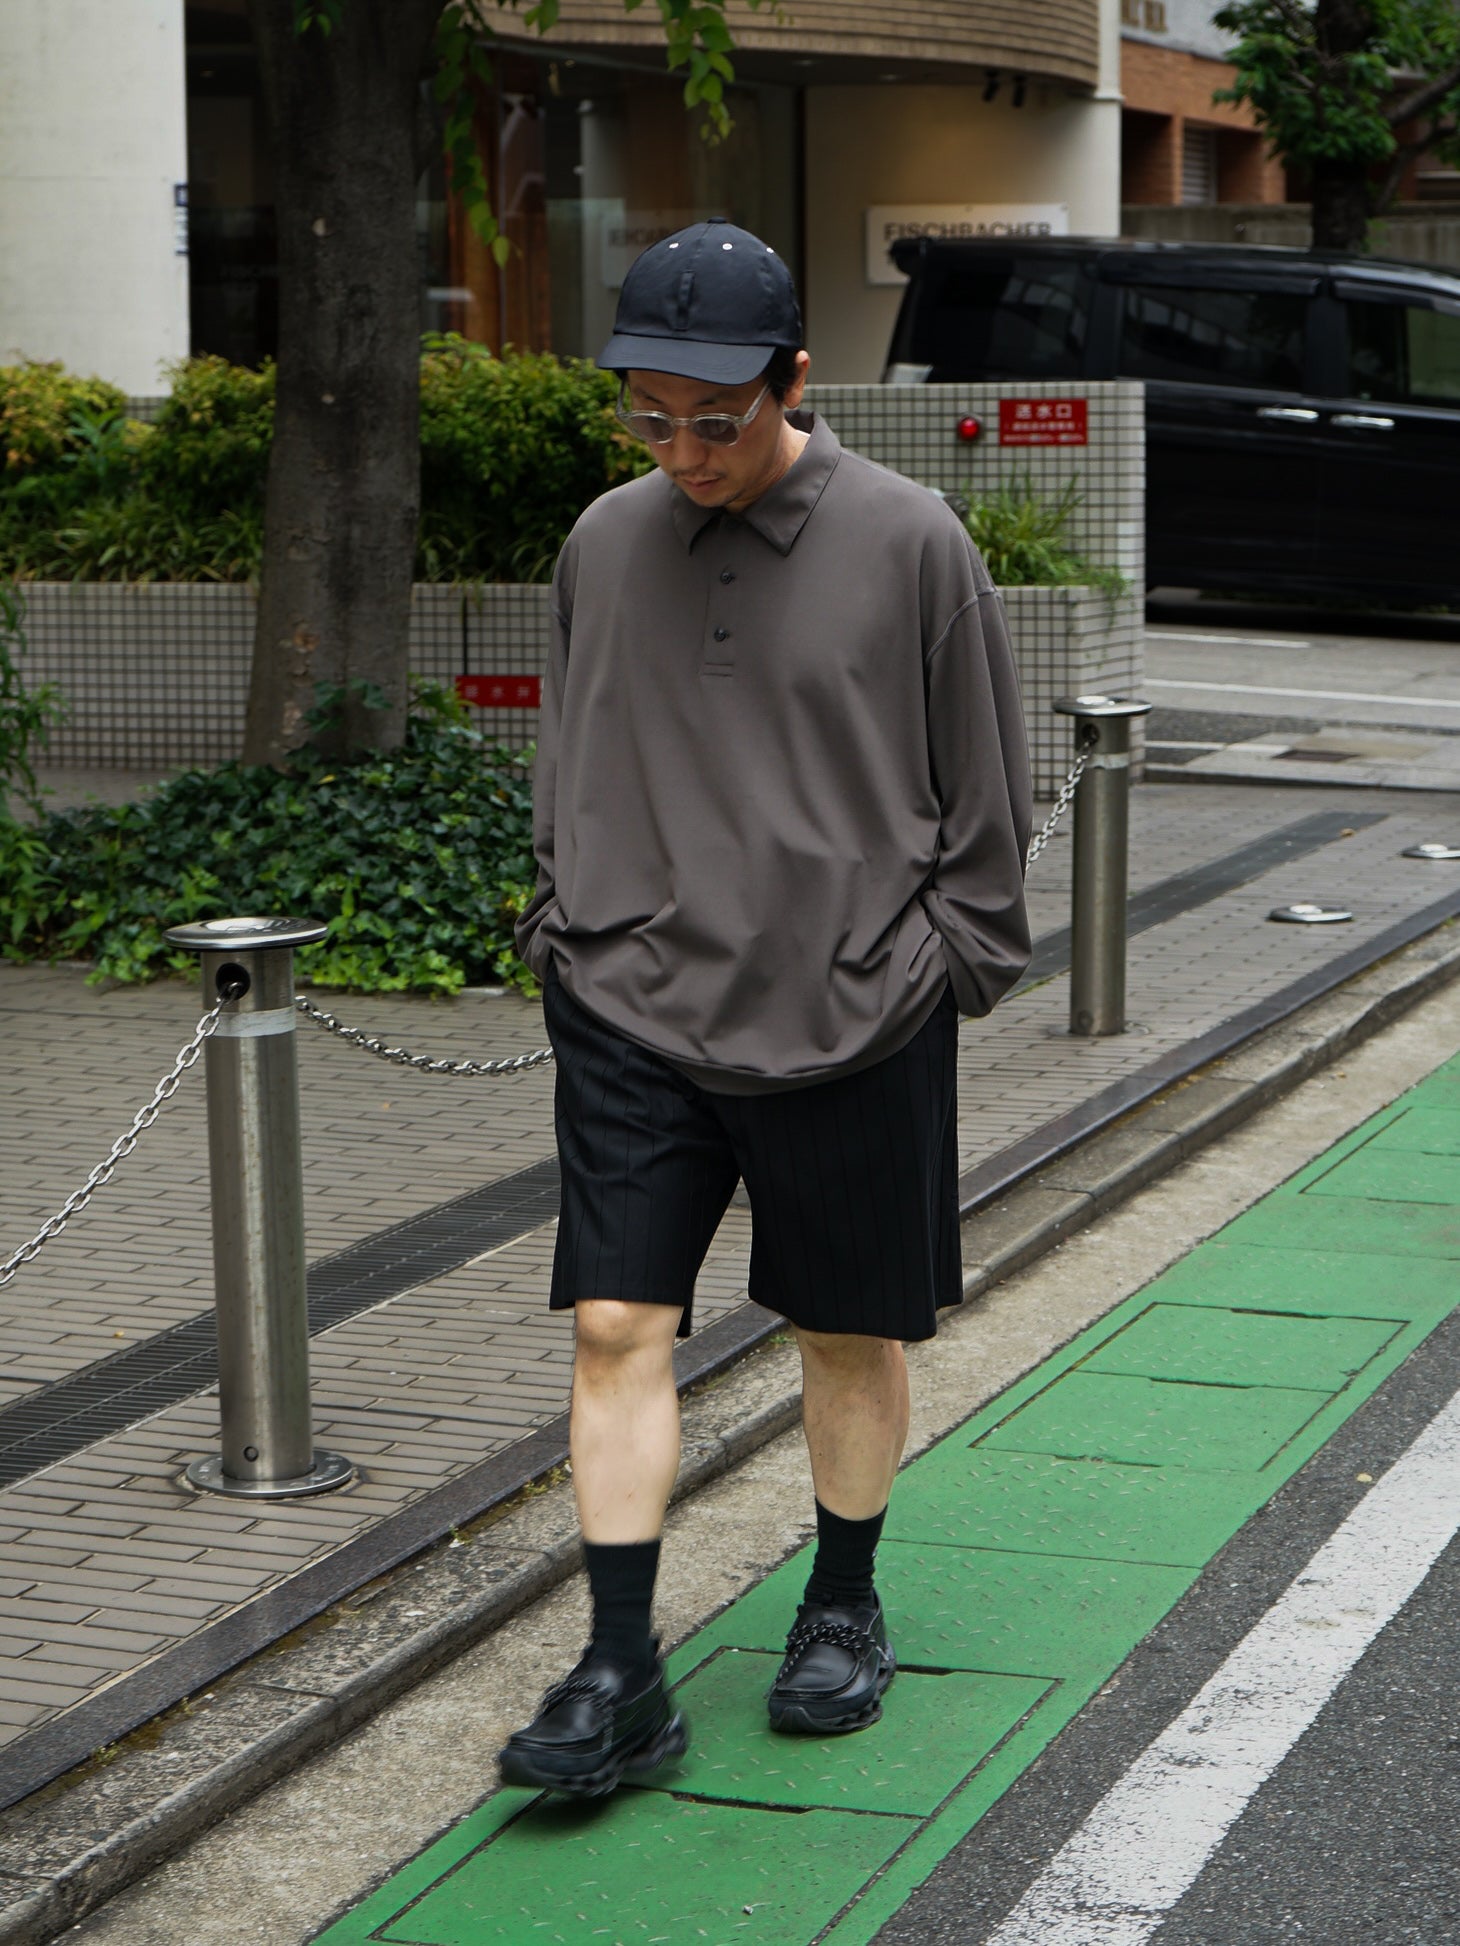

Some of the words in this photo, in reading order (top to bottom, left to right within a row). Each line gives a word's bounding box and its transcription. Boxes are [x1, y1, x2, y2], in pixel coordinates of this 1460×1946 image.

[884, 221, 1052, 241] FISCHBACHER
[1015, 403, 1072, 419] 送水口
